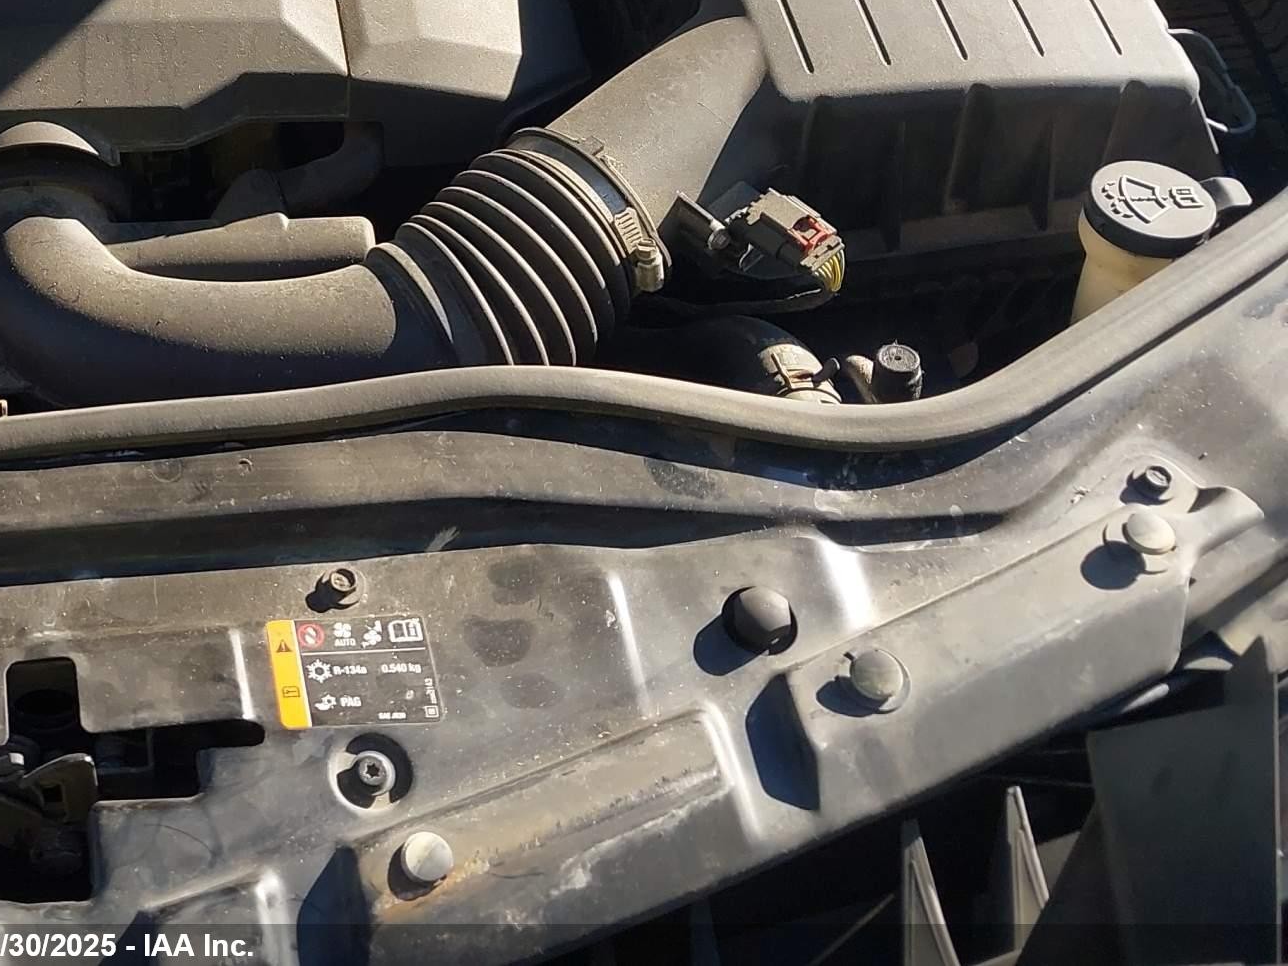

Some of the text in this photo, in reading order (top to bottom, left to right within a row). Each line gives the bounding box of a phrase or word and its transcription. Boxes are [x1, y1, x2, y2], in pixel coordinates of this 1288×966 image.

[334, 638, 356, 647] AUTO
[333, 665, 368, 675] R-134a
[381, 662, 422, 674] 0.540 kg
[339, 696, 362, 707] PAG
